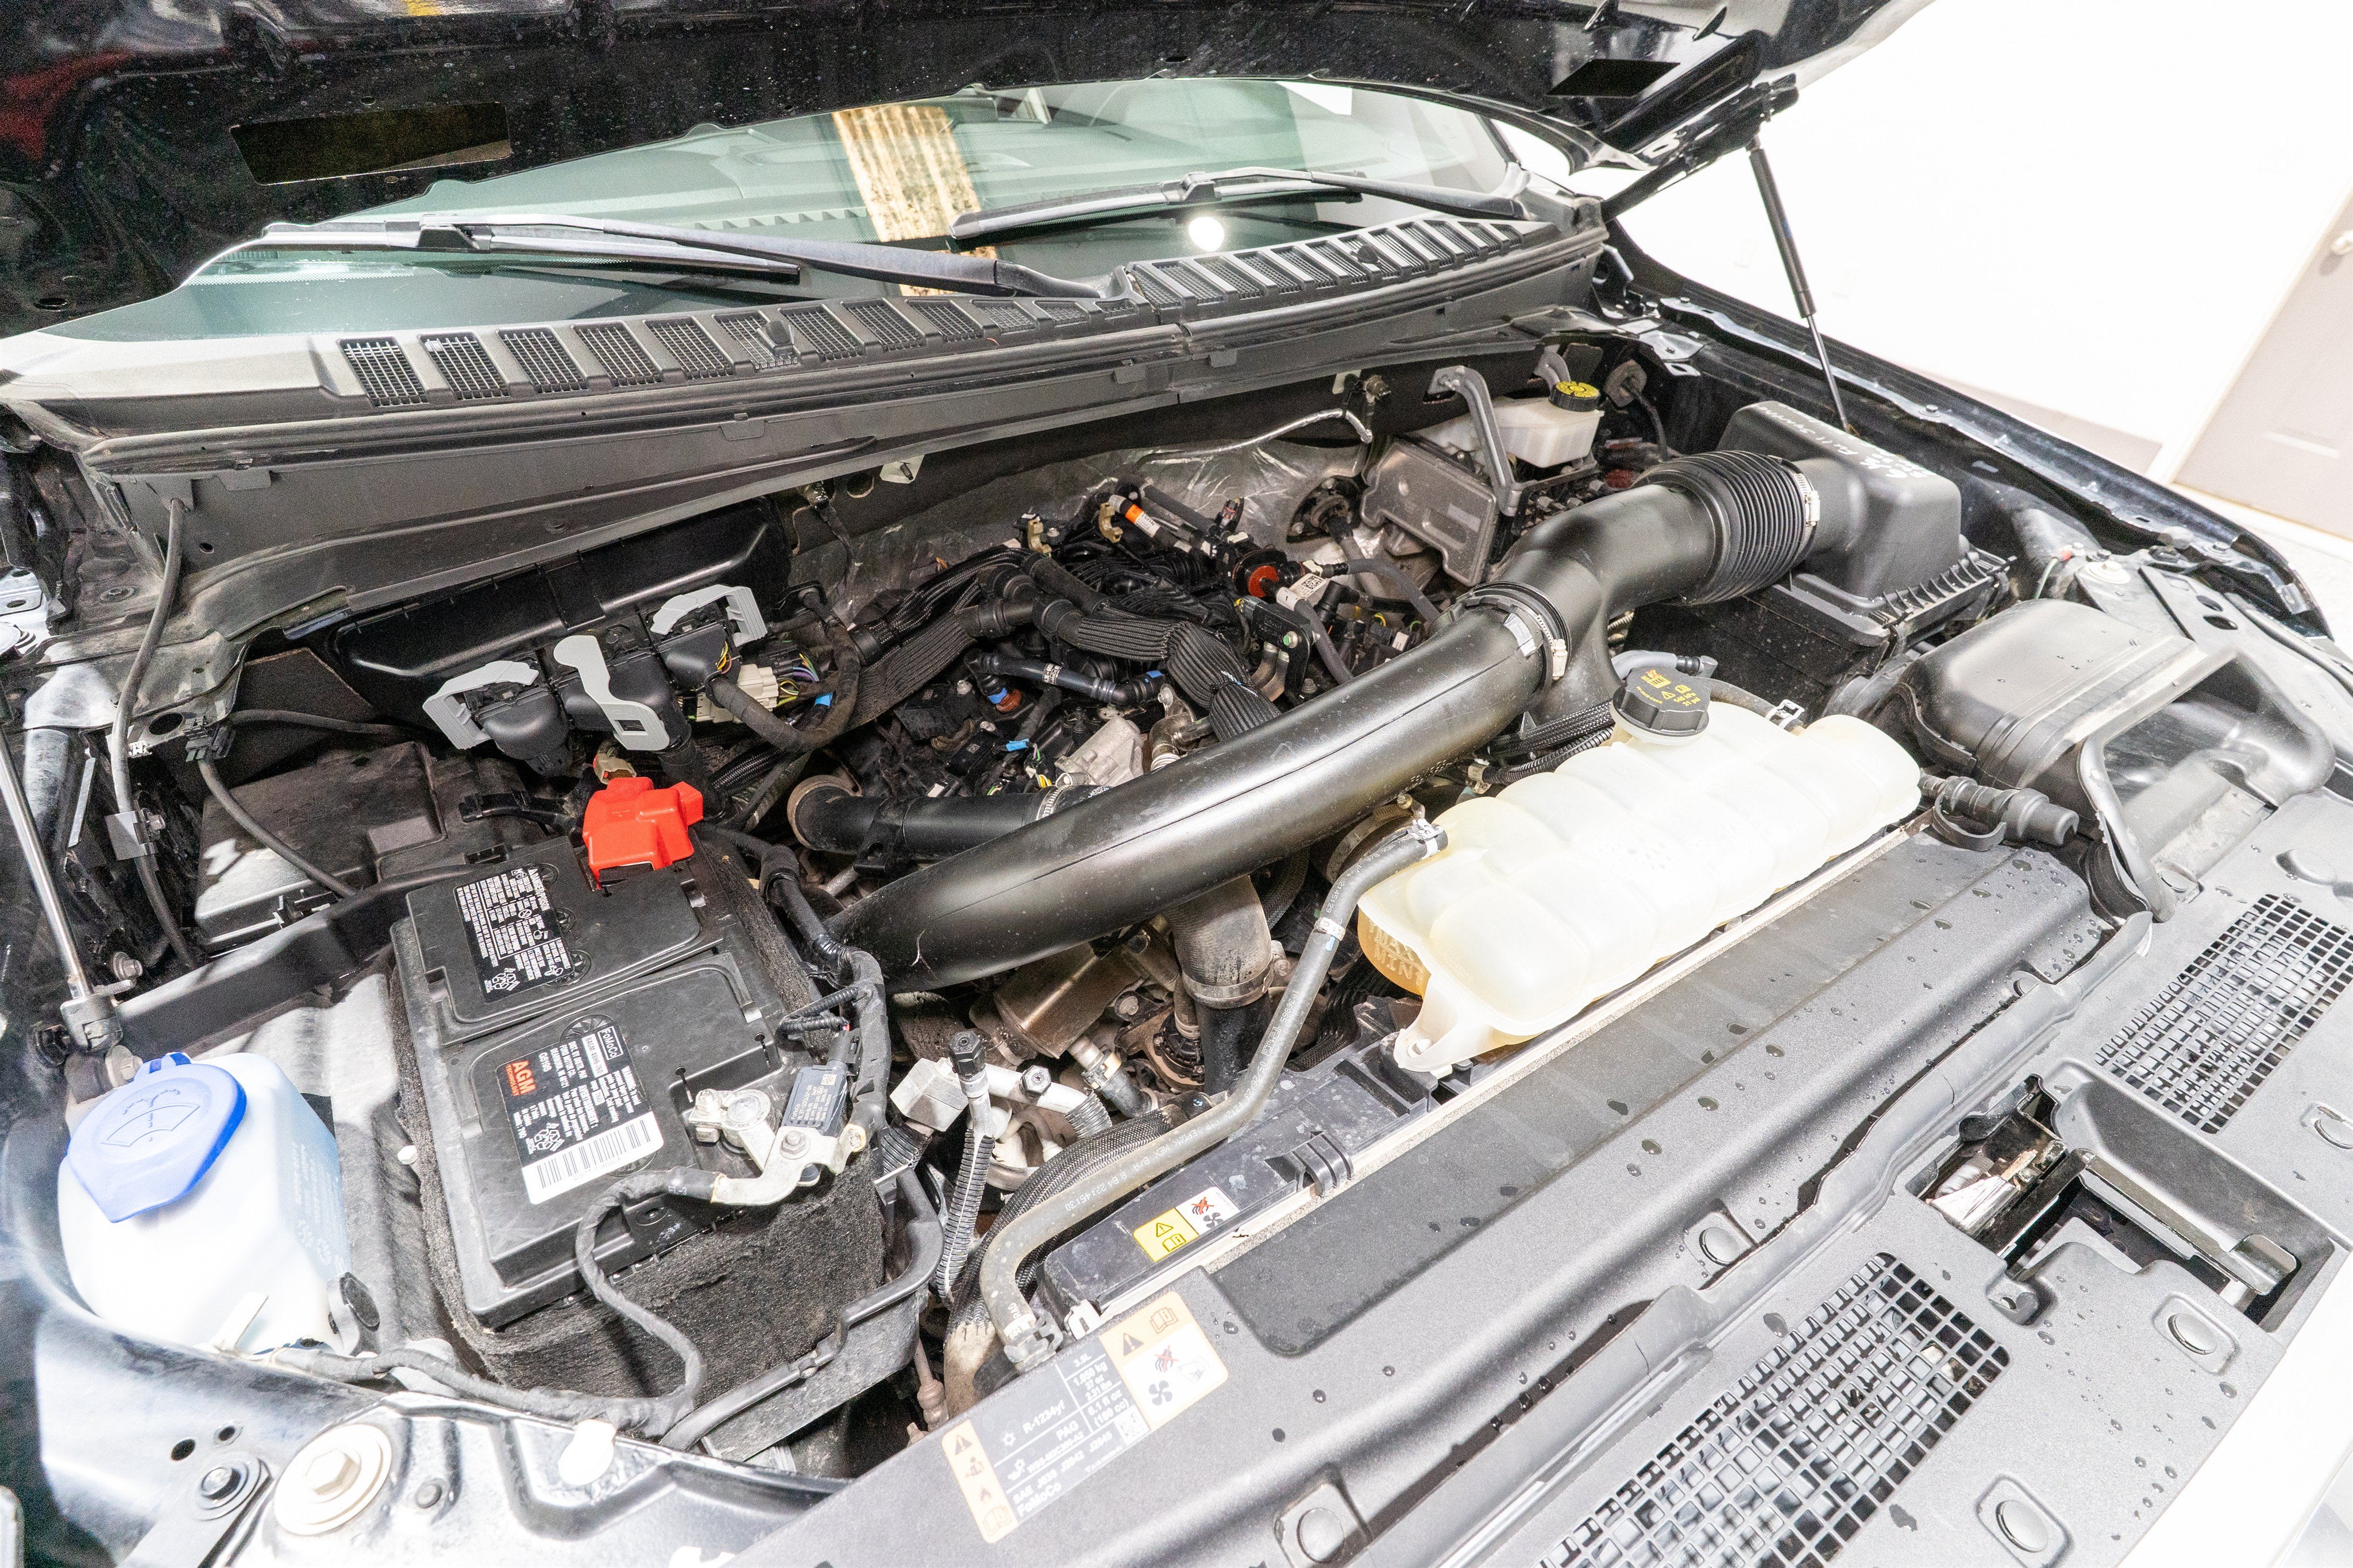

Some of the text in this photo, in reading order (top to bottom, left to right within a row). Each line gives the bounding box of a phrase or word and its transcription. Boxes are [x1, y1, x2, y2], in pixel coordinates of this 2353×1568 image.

[1375, 926, 1414, 961] MAX
[1374, 944, 1414, 979] MIN
[600, 1028, 620, 1058] FoMoCo
[1262, 1027, 1280, 1055] FoMoCo
[504, 1063, 520, 1098] TECHNOLOGY
[511, 1057, 537, 1095] AGM
[1243, 1060, 1267, 1100] 05/26/23
[1152, 1143, 1170, 1158] MEX
[1063, 1183, 1107, 1212] 22:45:30
[1021, 1399, 1069, 1434] R-1234yf
[1055, 1419, 1080, 1440] PAG
[1015, 1480, 1063, 1517] FoMoCo
